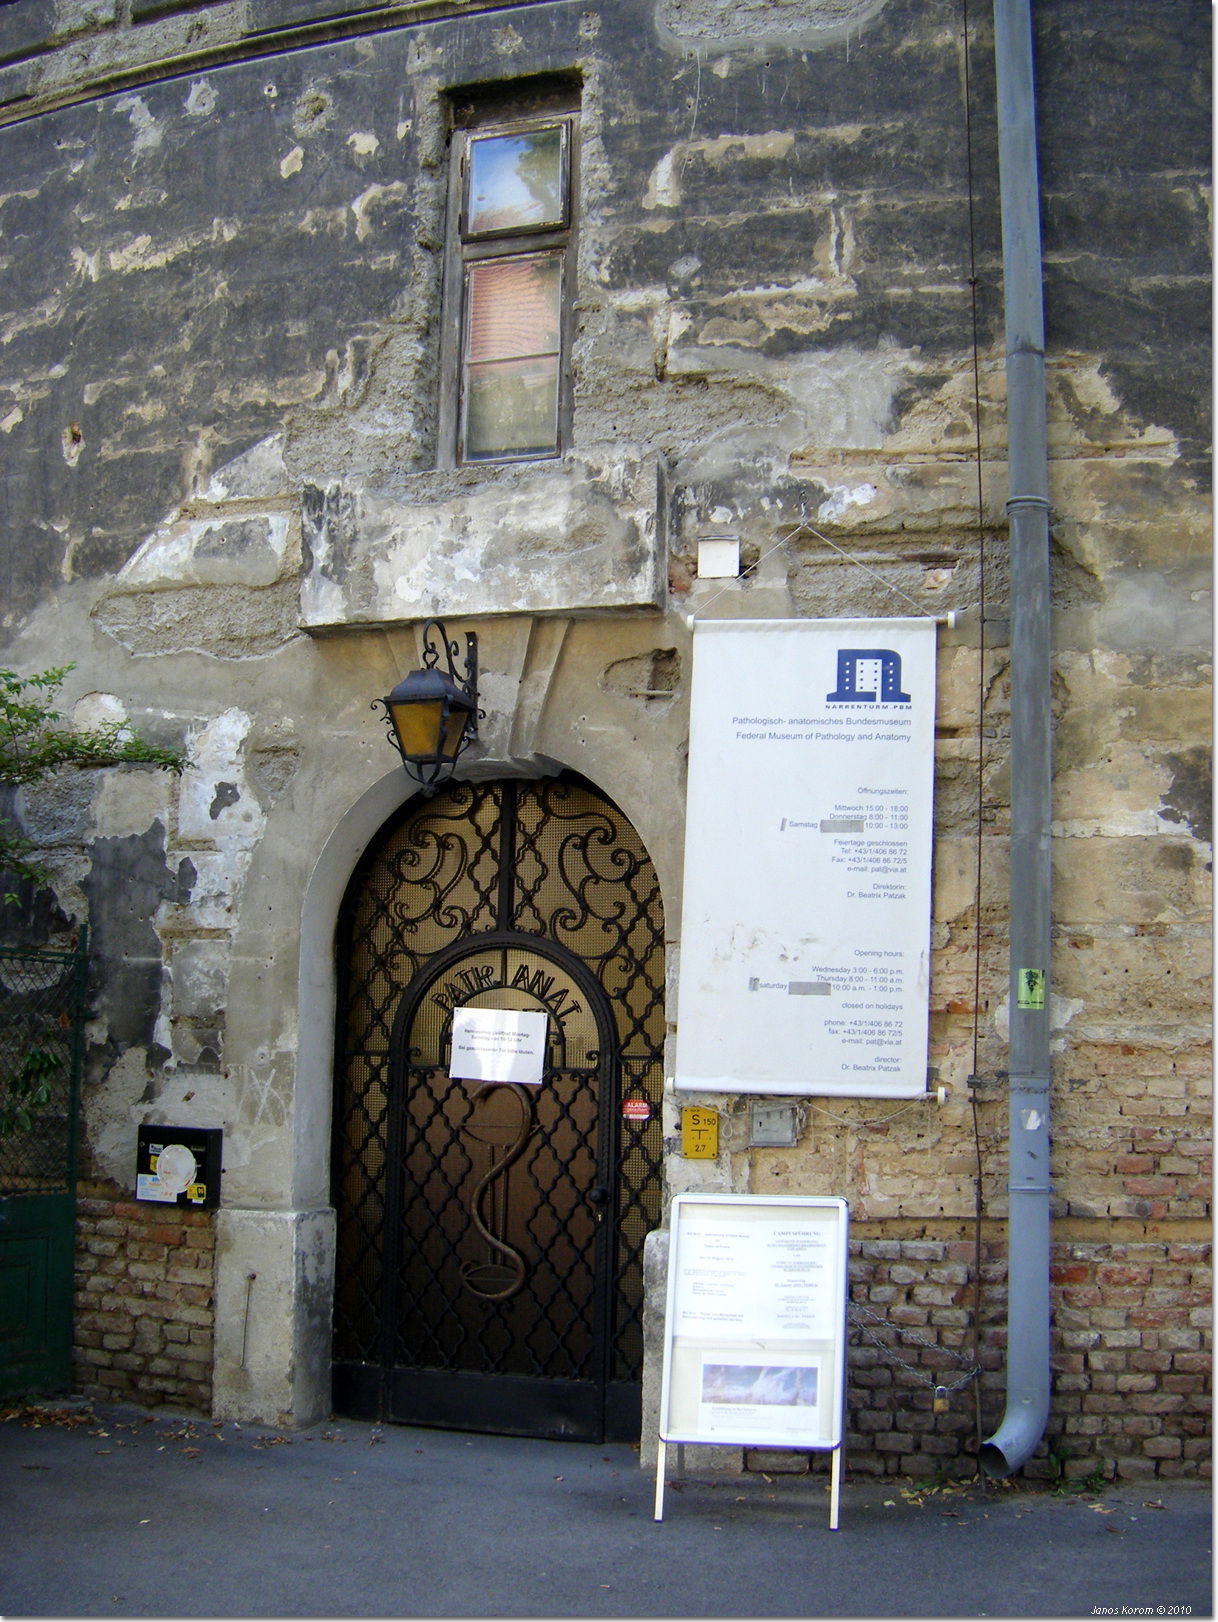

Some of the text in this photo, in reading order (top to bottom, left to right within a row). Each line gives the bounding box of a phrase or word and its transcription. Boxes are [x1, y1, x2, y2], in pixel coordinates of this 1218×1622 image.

[732, 716, 912, 727] Pathologisch- anatomisches Bundesmuseum
[736, 732, 912, 743] Federal Museum of Pathology and Anatomy
[834, 804, 864, 812] Mittwoch
[829, 813, 867, 821] Donnerstag
[789, 821, 818, 829] Samstag
[834, 839, 908, 848] Feiertage geschlossen
[854, 950, 883, 958] Opening
[812, 966, 851, 975] Wednesday
[816, 975, 847, 983] Thursday
[759, 982, 787, 991] saturday
[875, 1003, 903, 1011] holidays
[692, 1114, 716, 1126] S 150
